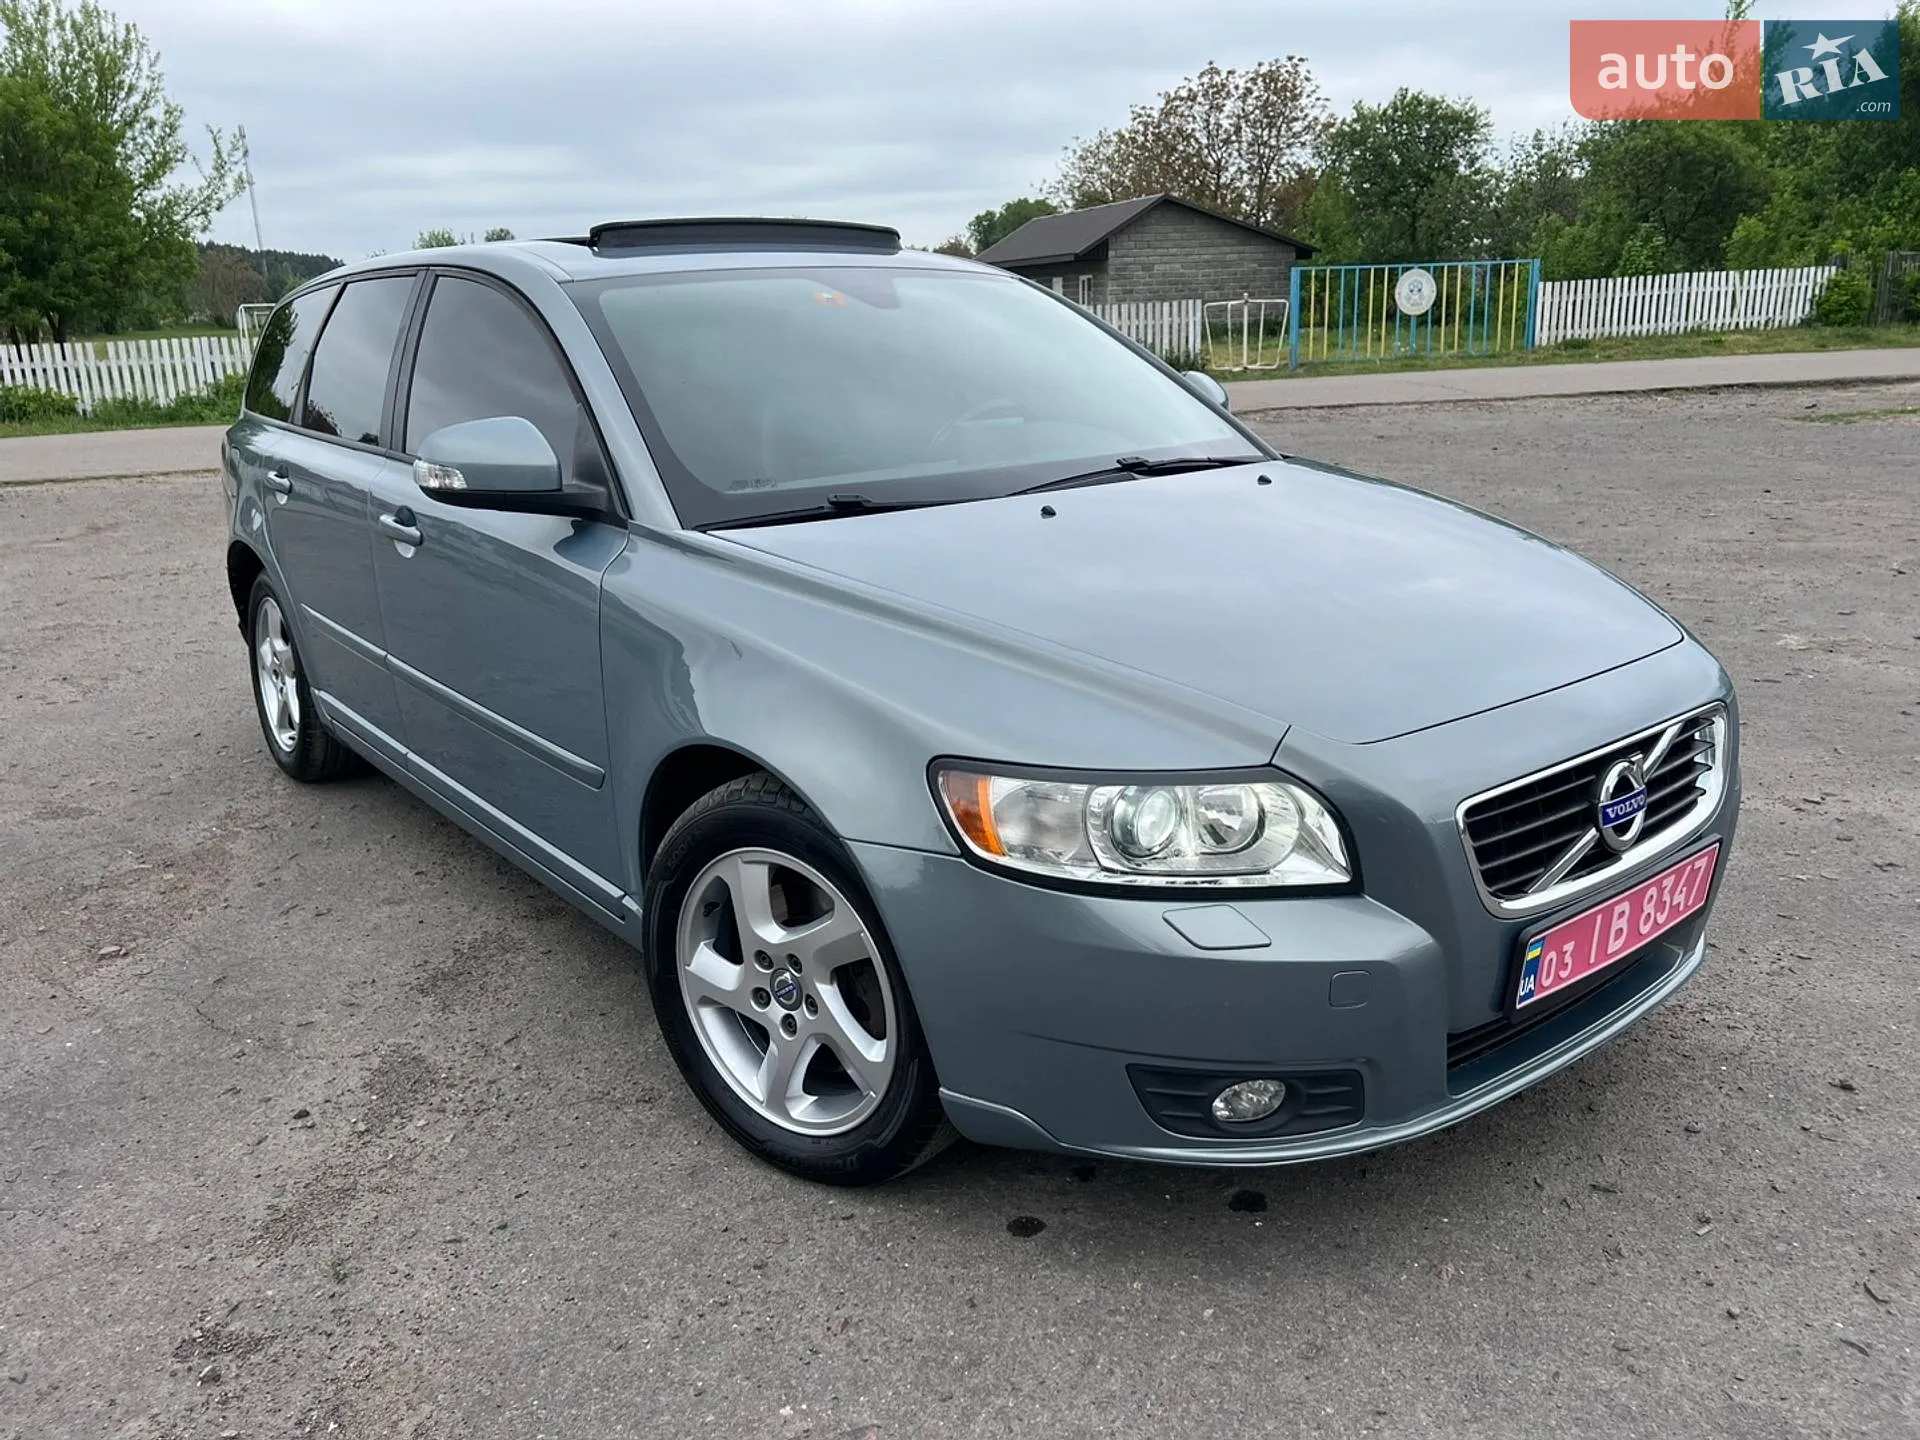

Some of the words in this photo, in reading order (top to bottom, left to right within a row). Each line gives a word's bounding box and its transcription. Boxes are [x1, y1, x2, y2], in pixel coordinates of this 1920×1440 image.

[1606, 794, 1645, 818] VOLVO
[1541, 940, 1575, 987] 03
[1639, 856, 1708, 934] 8347
[1520, 980, 1535, 996] UA
